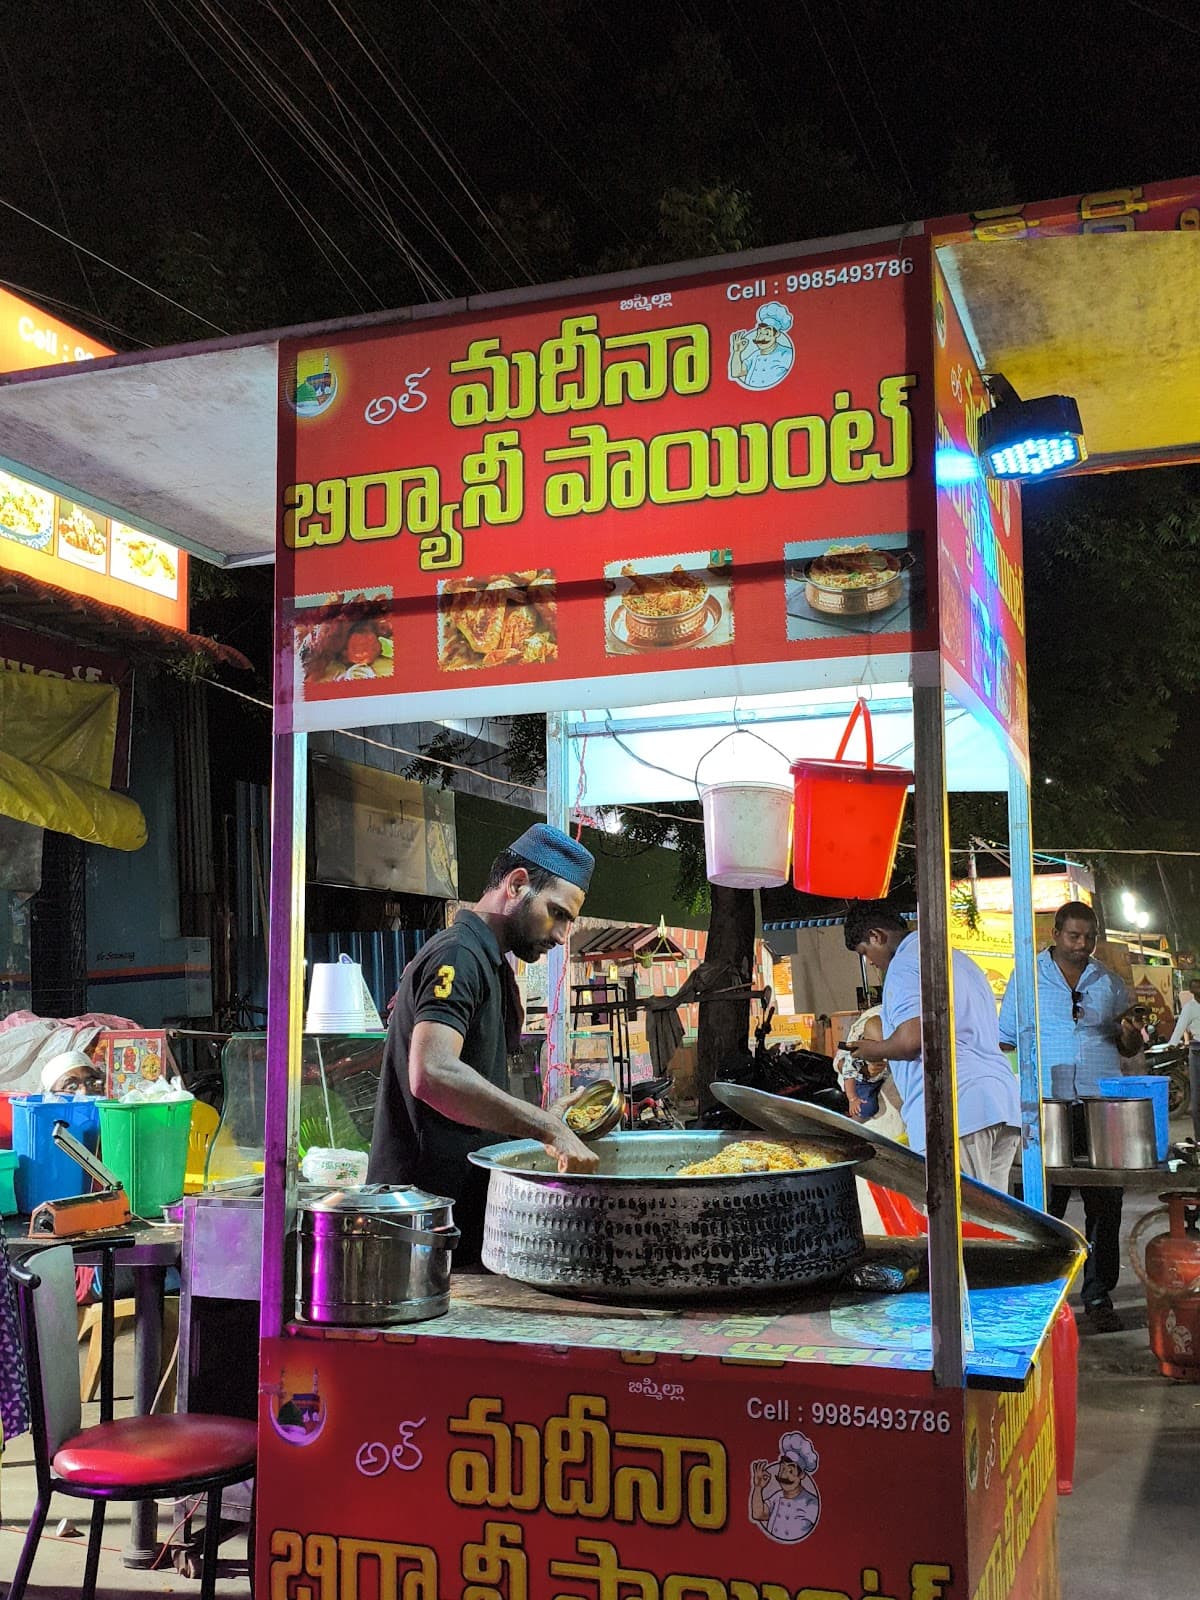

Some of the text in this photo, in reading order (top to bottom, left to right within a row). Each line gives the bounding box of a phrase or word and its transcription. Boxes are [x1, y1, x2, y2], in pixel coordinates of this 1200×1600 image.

[726, 280, 766, 302] Cell
[786, 257, 915, 293] 9985493786
[620, 292, 673, 312] బిస్మిల్లా
[364, 313, 712, 427] అల్ మదీనా
[283, 428, 525, 571] బిర్యానీ
[543, 374, 917, 519] పాయింట్
[434, 964, 456, 999] 3
[628, 1377, 686, 1401] బిస్మిల్లా
[746, 1397, 789, 1421] Cell
[811, 1402, 951, 1434] 9985493786
[355, 1393, 729, 1532] అల్ మదీనా
